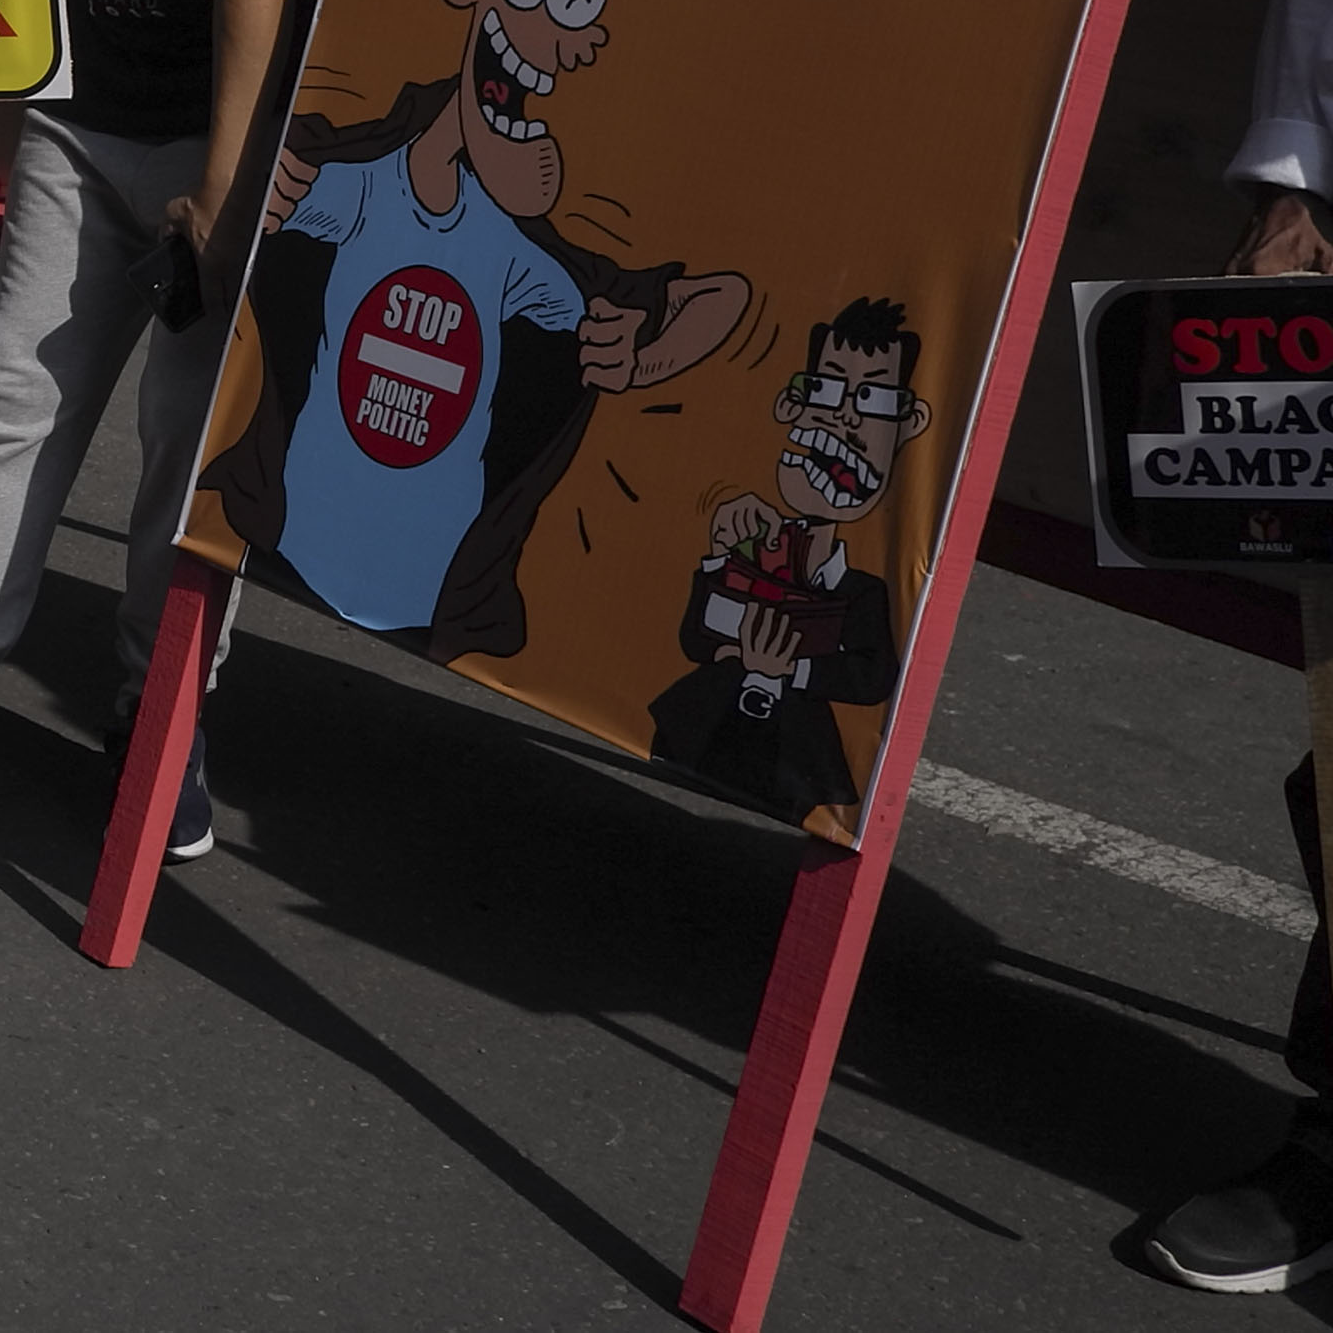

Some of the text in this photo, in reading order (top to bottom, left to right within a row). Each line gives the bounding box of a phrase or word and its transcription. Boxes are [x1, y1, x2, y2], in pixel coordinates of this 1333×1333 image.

[383, 283, 464, 346] STOP
[367, 373, 435, 418] MONEY
[356, 398, 430, 447] POLITIC
[1239, 541, 1294, 554] BAWASLU
